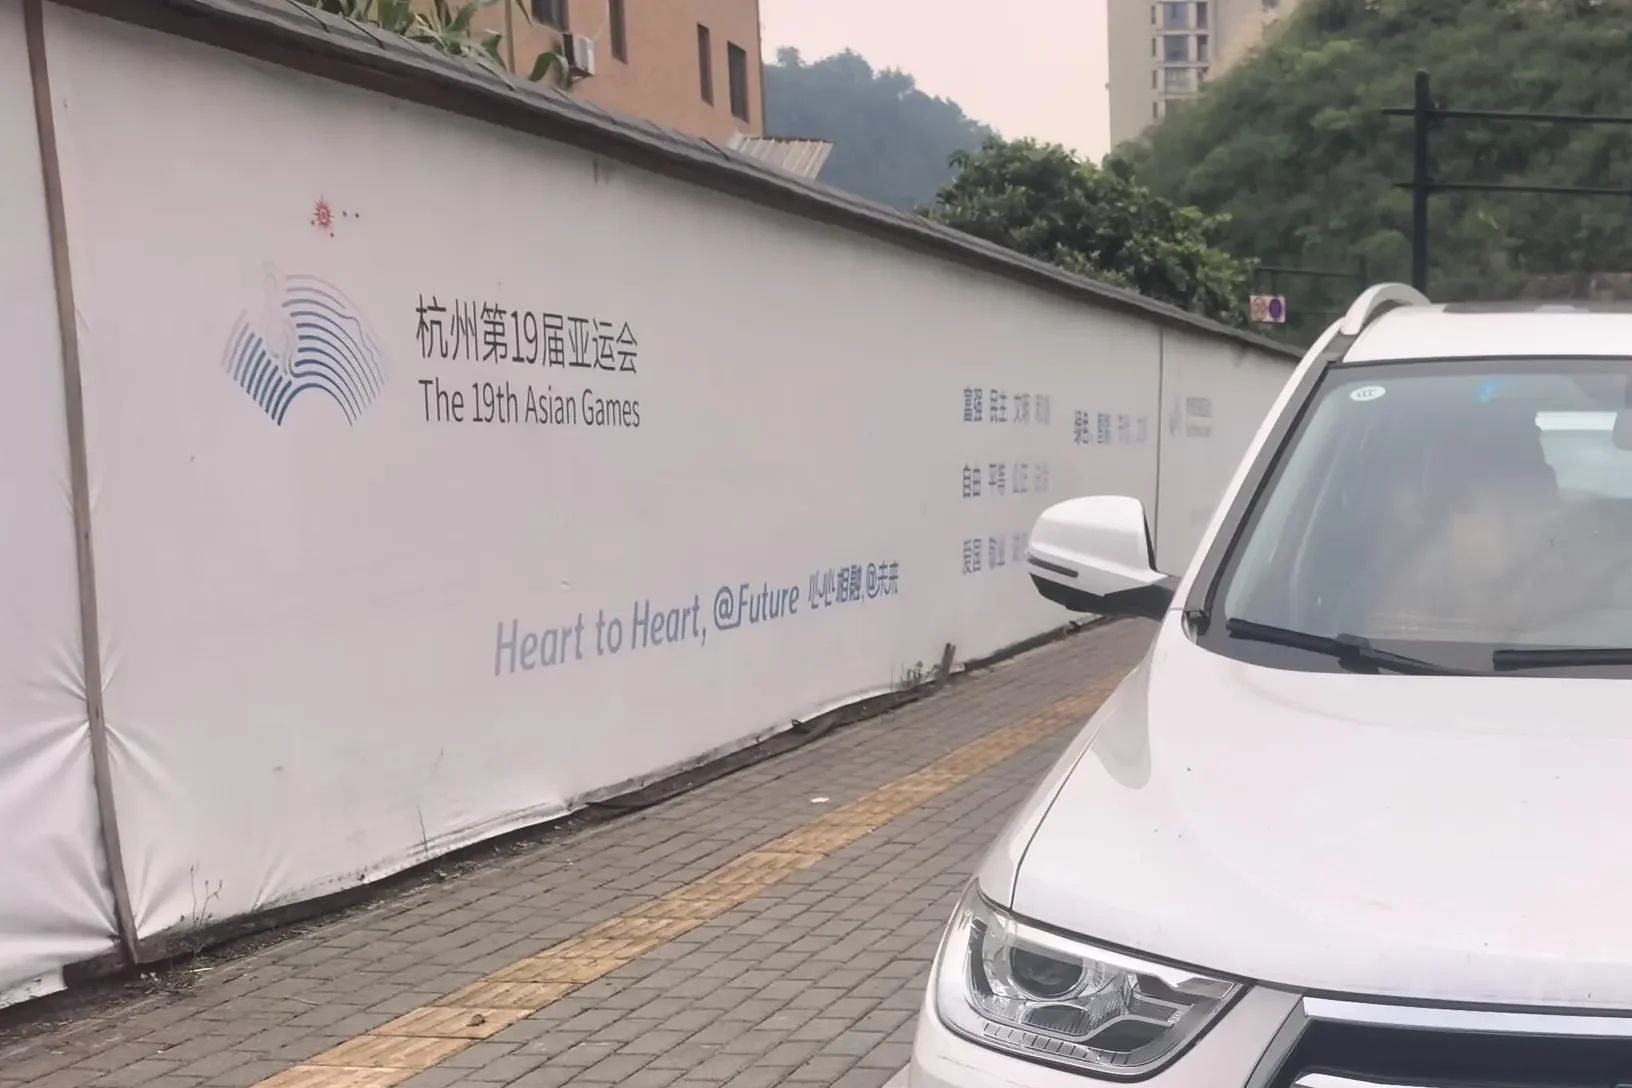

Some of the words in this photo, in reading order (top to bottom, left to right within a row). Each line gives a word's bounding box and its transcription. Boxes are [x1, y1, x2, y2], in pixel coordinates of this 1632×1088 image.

[416, 293, 638, 373] 杭州第19届亚运会
[418, 377, 464, 422] The
[472, 381, 518, 423] 19th
[525, 385, 576, 424] Asian
[582, 388, 640, 427] Games
[494, 613, 584, 676] Heart
[595, 609, 622, 655] to
[632, 595, 706, 650] Heart,
[714, 582, 800, 631] @Future
